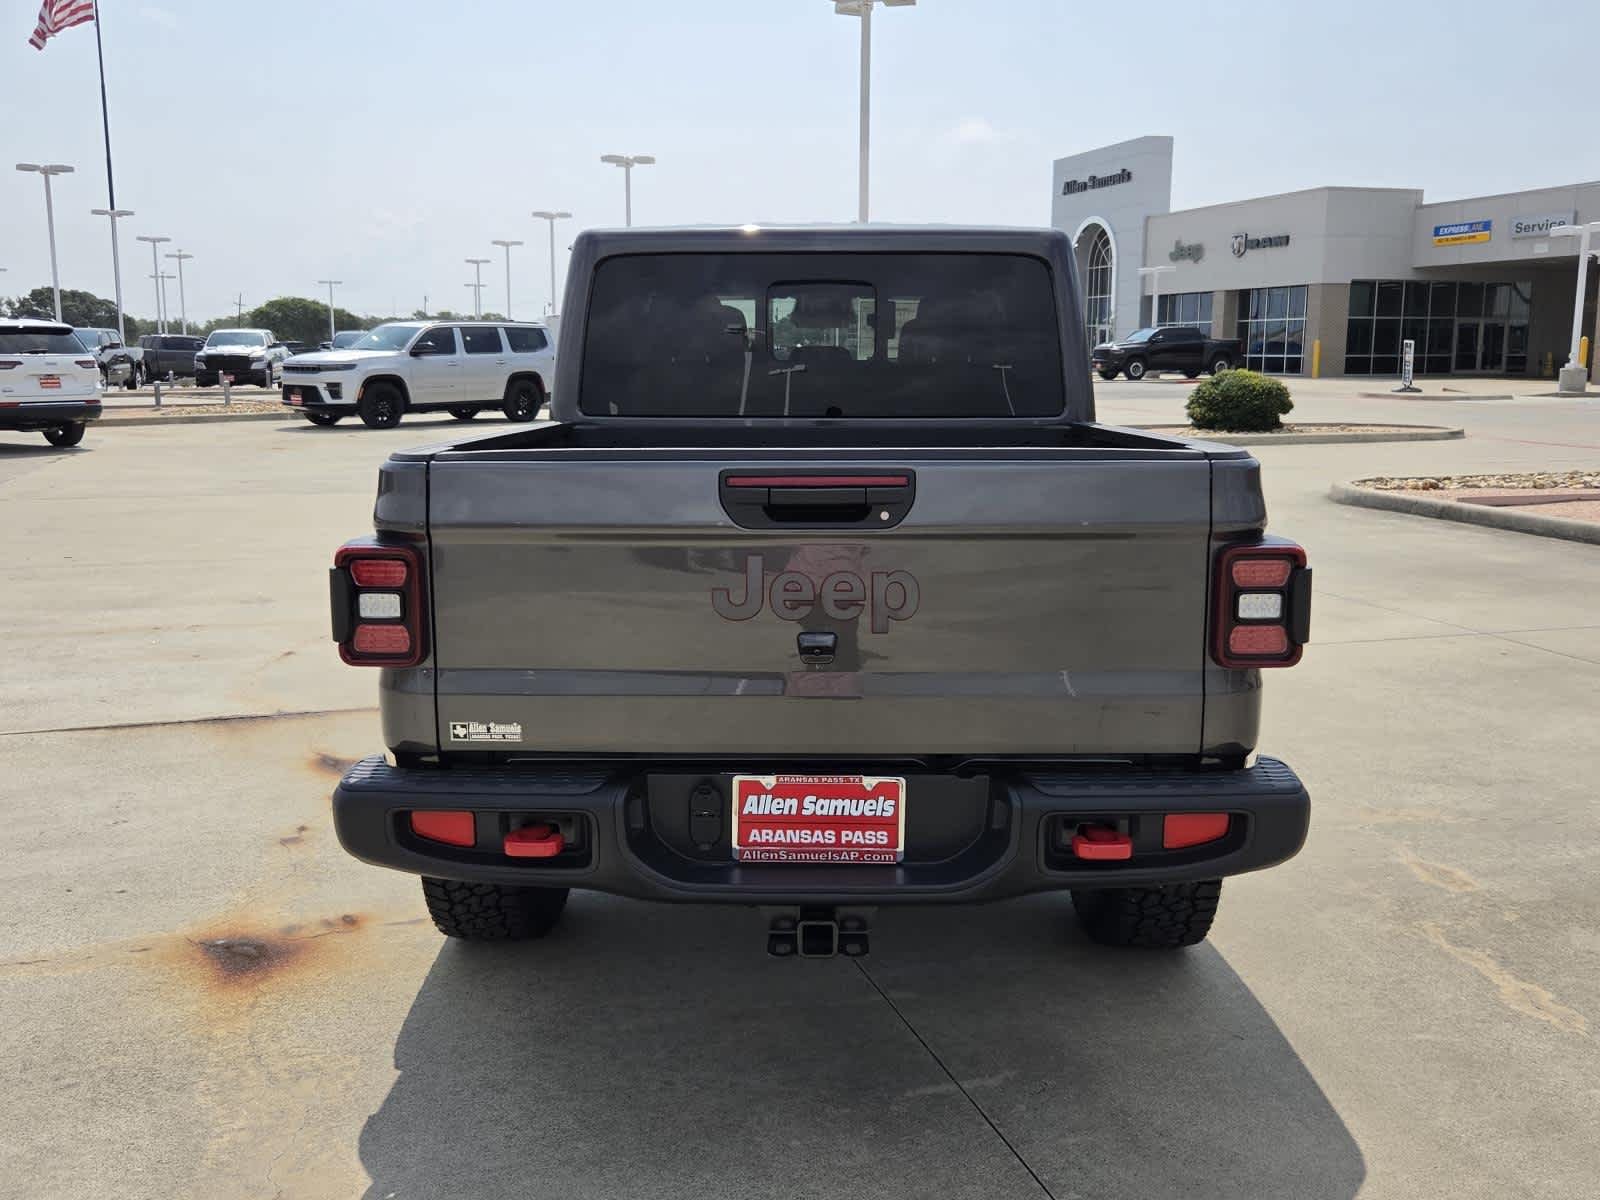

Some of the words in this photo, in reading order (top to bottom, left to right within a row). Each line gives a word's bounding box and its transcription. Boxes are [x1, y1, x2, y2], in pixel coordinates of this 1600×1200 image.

[711, 555, 920, 634] Jeep
[743, 795, 799, 816] Allen
[801, 795, 896, 817] Samuels
[748, 829, 836, 844] ARANSAS
[841, 830, 889, 844] PASS
[743, 850, 894, 862] AllenSamuelsAP.com
